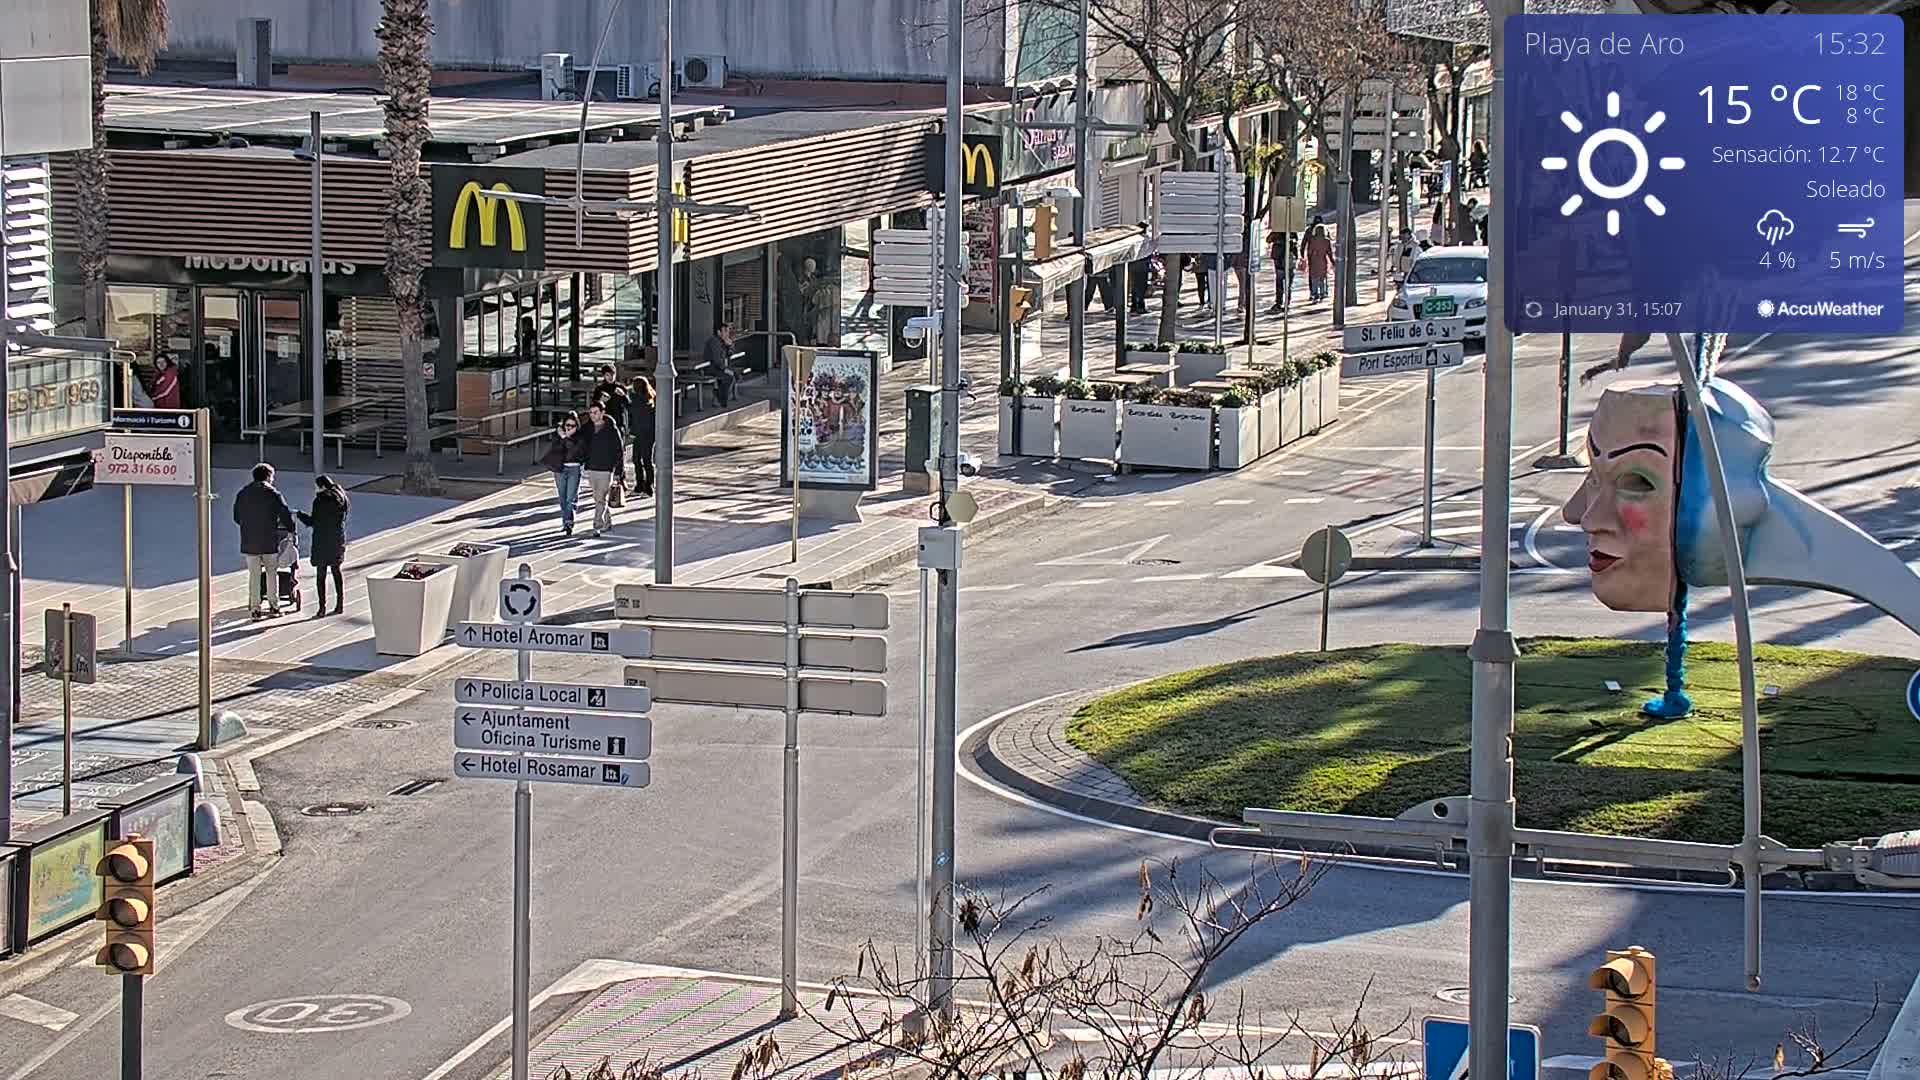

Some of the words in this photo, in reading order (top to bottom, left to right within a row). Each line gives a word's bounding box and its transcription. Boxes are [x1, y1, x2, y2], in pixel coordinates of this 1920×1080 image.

[1361, 328, 1376, 342] St.
[1380, 325, 1404, 341] Feliu
[1409, 324, 1421, 338] de
[1425, 322, 1437, 337] G.
[1359, 358, 1379, 371] Port
[1383, 352, 1423, 368] Esportiu
[65, 382, 100, 407] 1969
[111, 446, 173, 463] Disponible
[108, 463, 129, 474] 972
[131, 463, 143, 474] 31
[146, 464, 161, 474] 65
[163, 465, 177, 475] 00
[481, 627, 522, 643] Hotel
[528, 629, 585, 647] Aromar
[481, 683, 534, 702] Policia
[539, 687, 581, 703] Local
[481, 711, 570, 730] Ajuntament
[481, 730, 535, 748] Oficina
[540, 733, 601, 752] Turisme
[481, 756, 521, 773] Hotel
[527, 760, 596, 778] Rosamar
